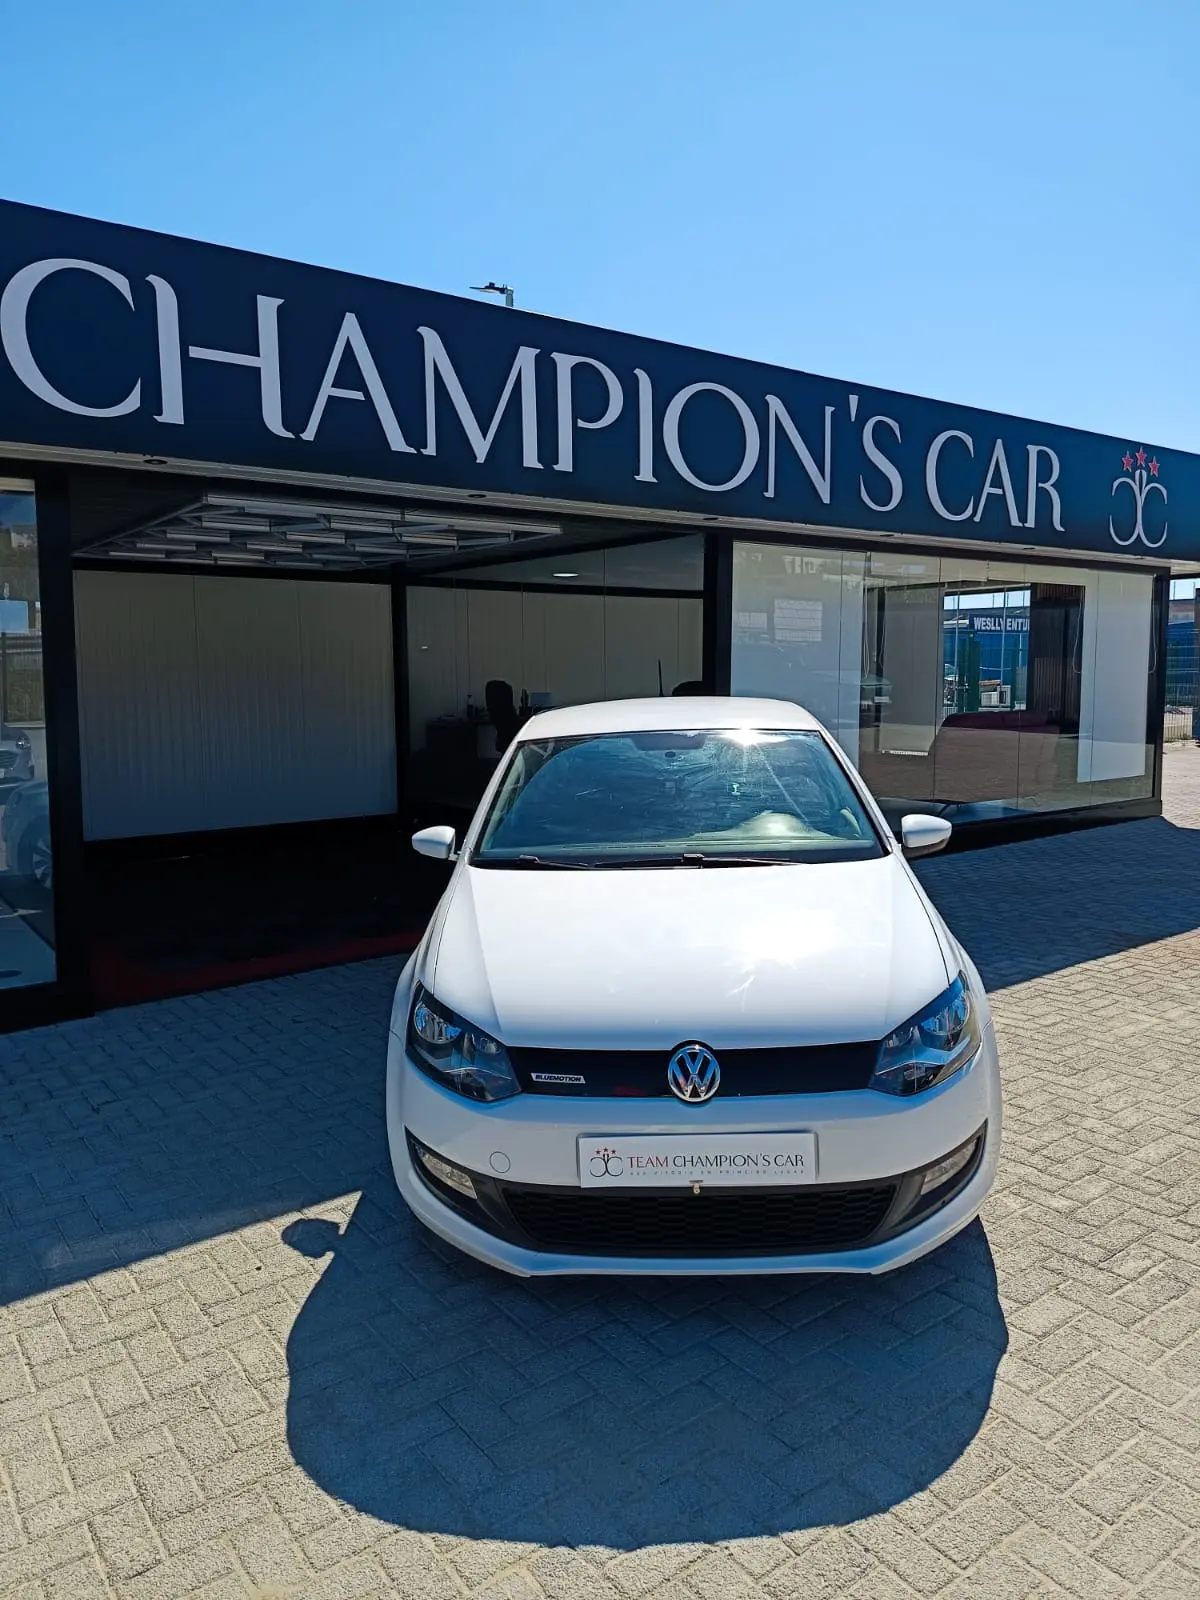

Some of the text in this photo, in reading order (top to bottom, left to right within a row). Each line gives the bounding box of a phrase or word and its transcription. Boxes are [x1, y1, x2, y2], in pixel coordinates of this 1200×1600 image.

[0, 257, 1065, 532] CHAMPION'S CAR
[627, 1153, 804, 1168] TEAM CHAMPION'S CAR
